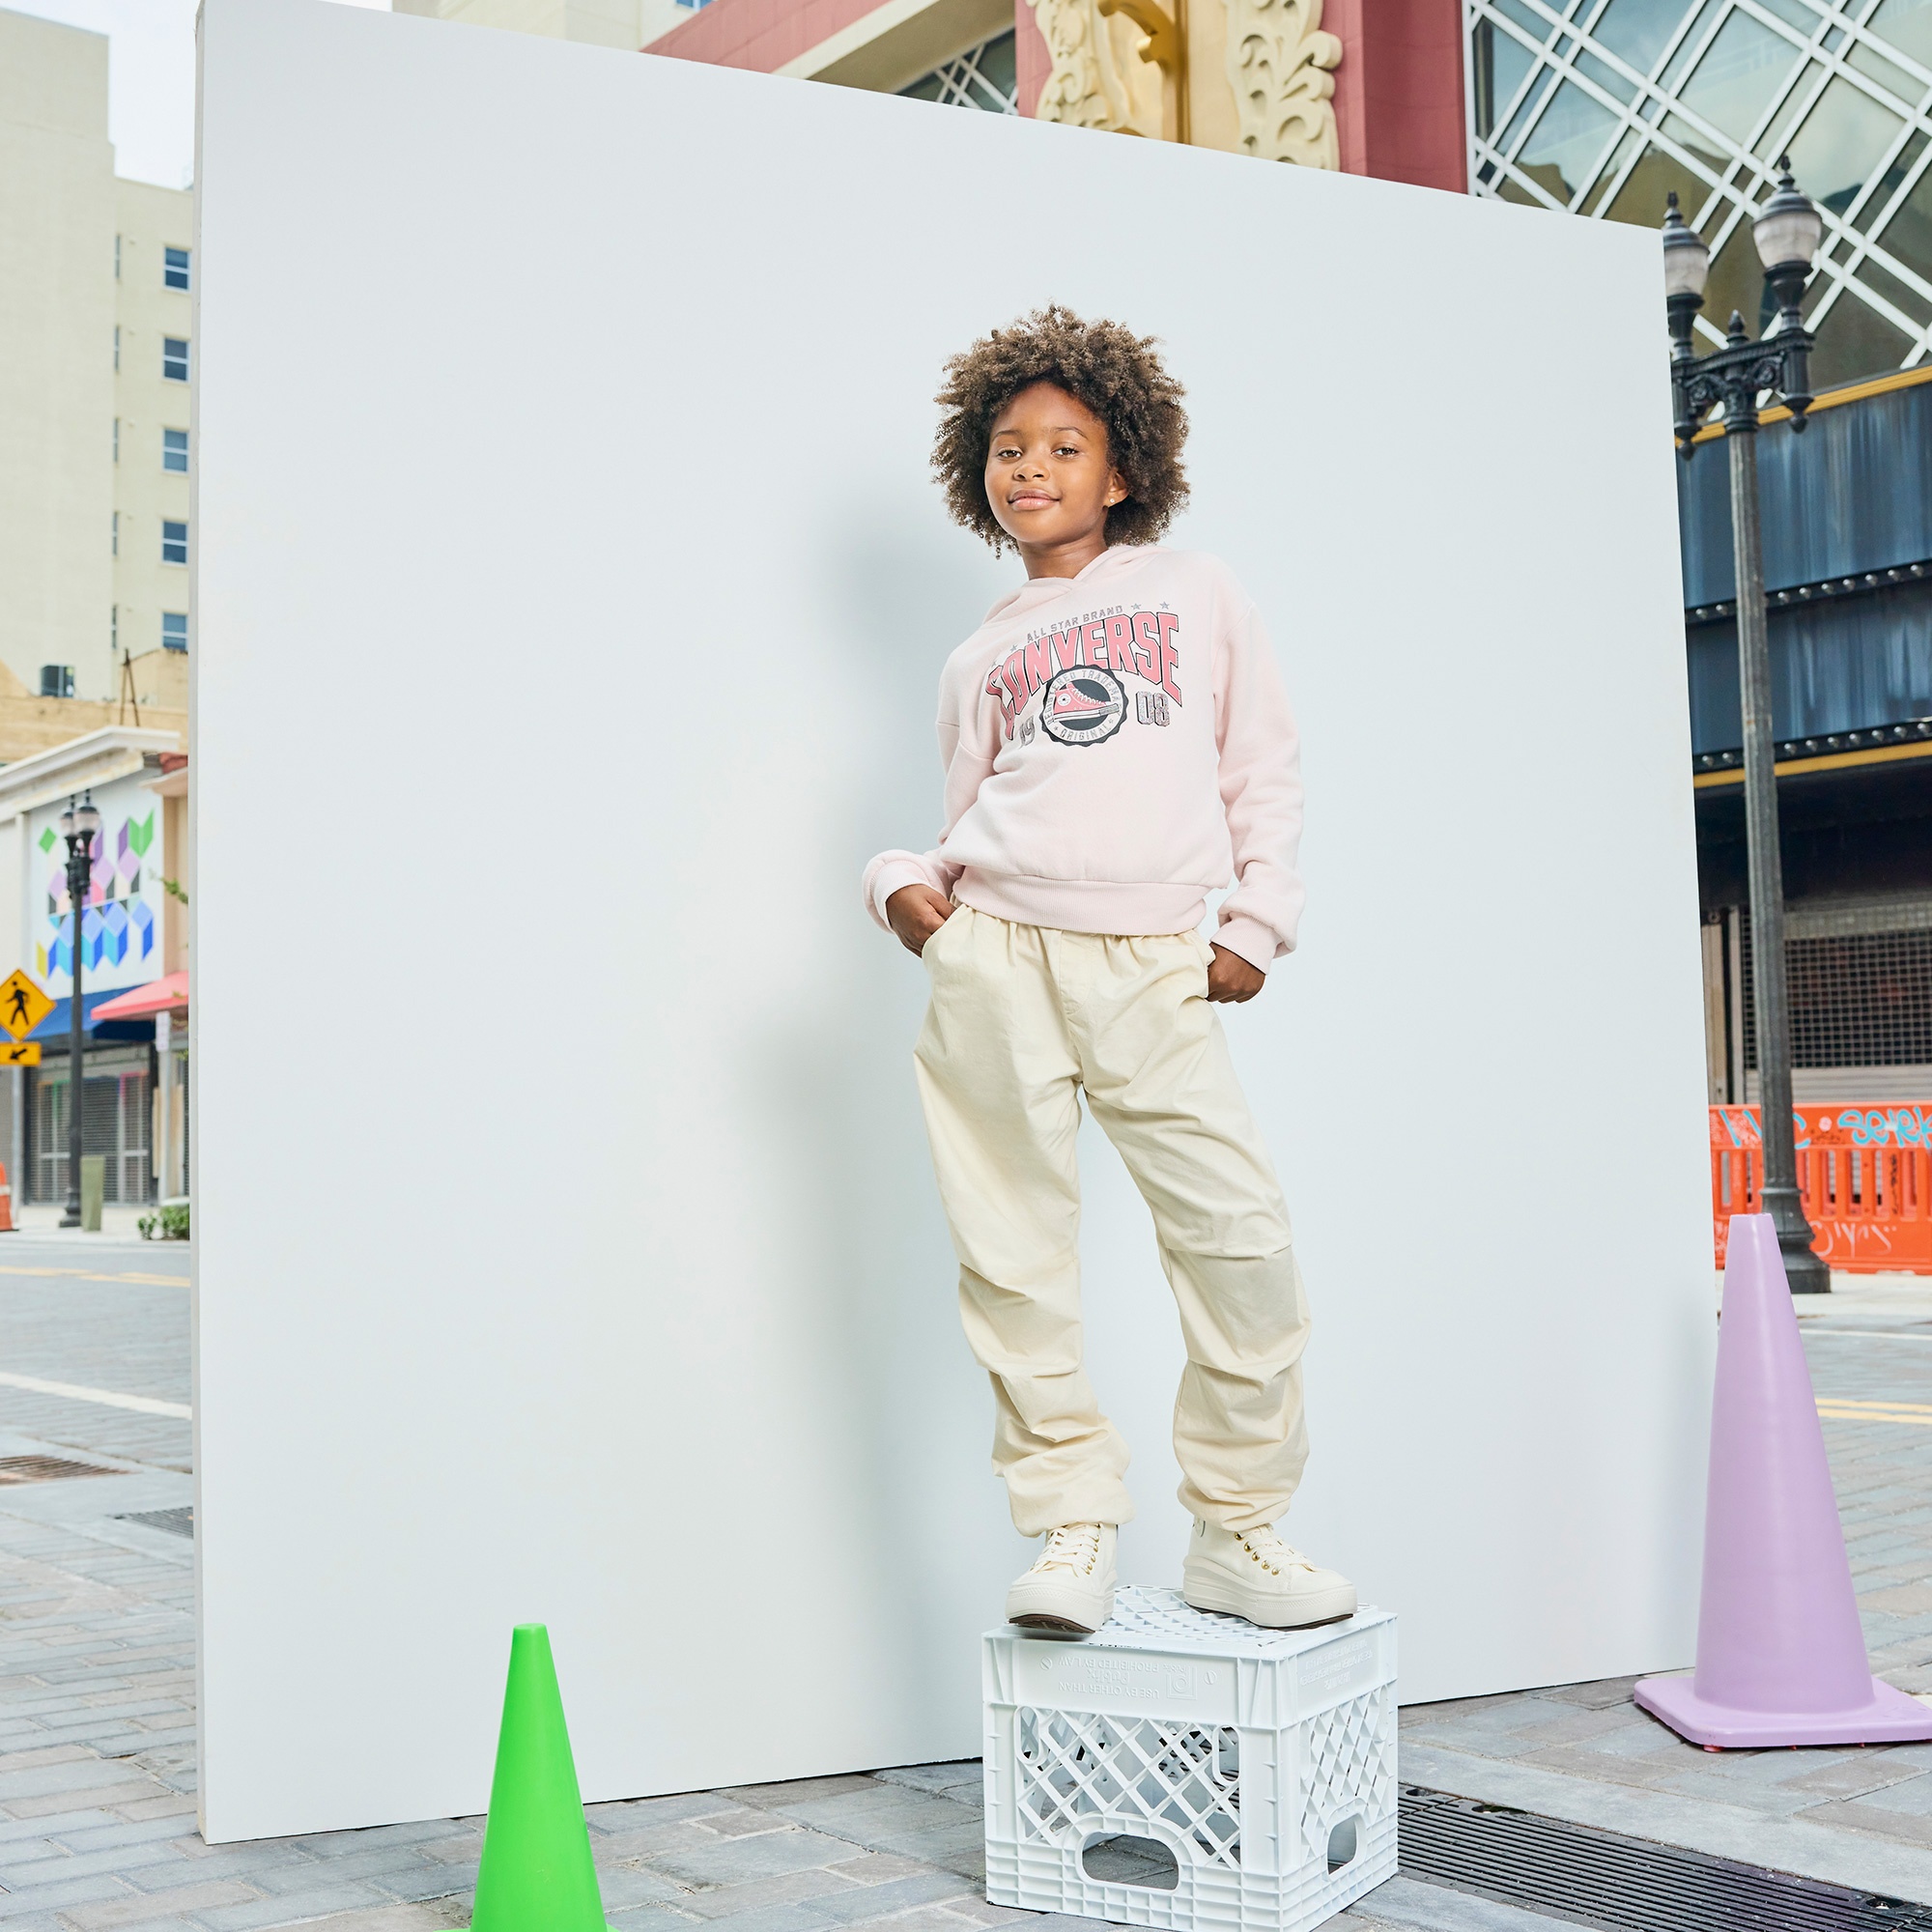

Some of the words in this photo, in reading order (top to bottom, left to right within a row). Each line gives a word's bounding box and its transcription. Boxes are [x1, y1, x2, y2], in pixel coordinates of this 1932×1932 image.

[1026, 627, 1046, 643] ALL
[1050, 617, 1079, 633] STAR
[1083, 605, 1123, 622] BRAND
[985, 611, 1182, 740] CONVERSE
[1135, 691, 1171, 726] 08
[1060, 724, 1112, 741] ORIGINAL
[1059, 1656, 1082, 1668] LAW
[1083, 1657, 1095, 1668] BY
[1098, 1658, 1159, 1673] PROHIBITED
[1059, 1681, 1089, 1693] THAN
[1089, 1684, 1122, 1696] OTHER
[1123, 1687, 1137, 1697] BY
[1139, 1688, 1160, 1699] USE
